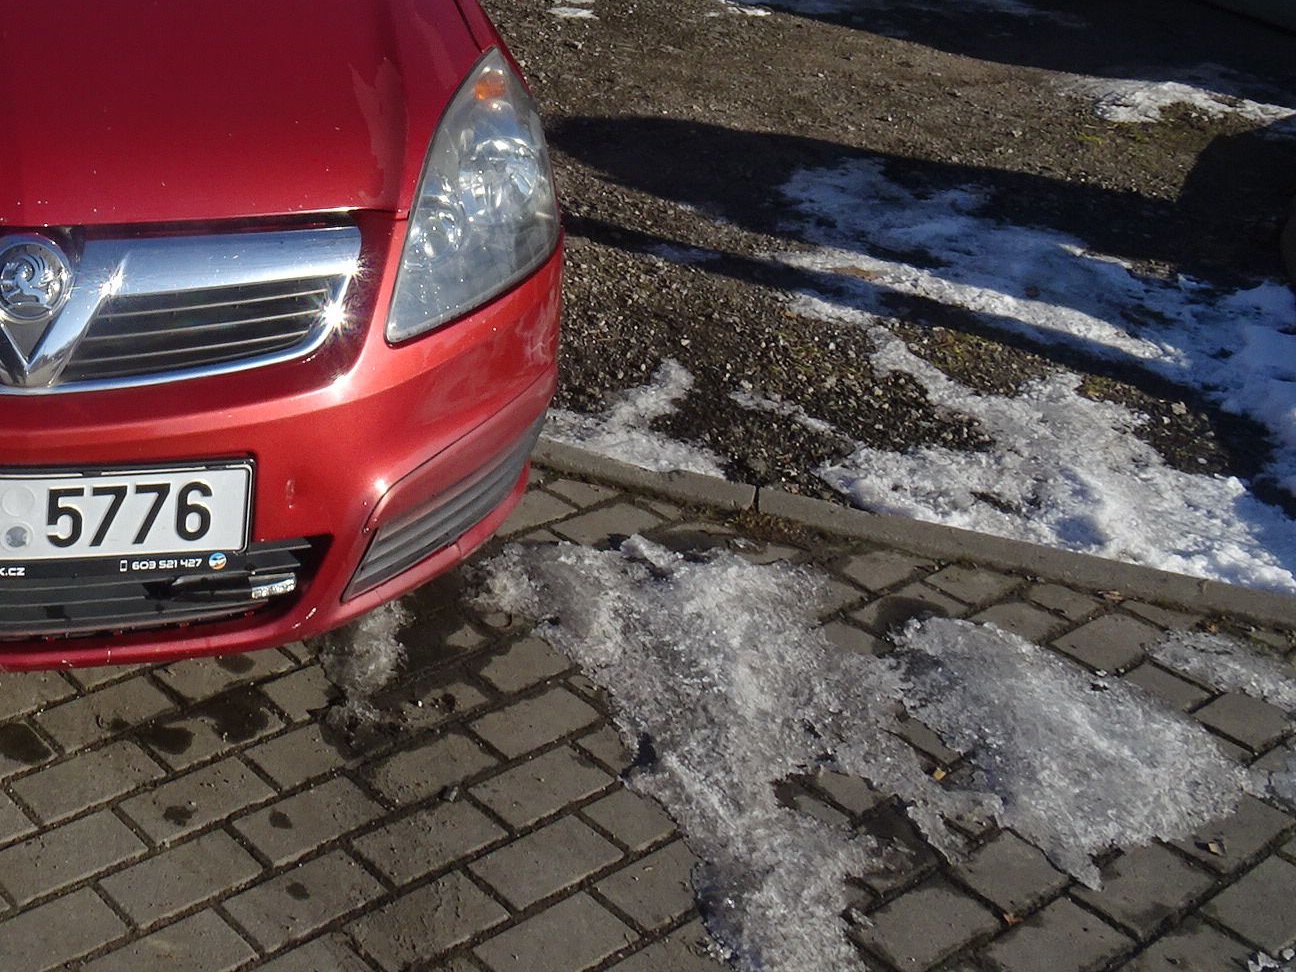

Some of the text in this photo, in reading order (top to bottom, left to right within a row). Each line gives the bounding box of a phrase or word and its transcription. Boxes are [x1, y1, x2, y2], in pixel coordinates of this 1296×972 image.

[46, 481, 214, 548] 5776
[131, 558, 203, 571] 603 521 427
